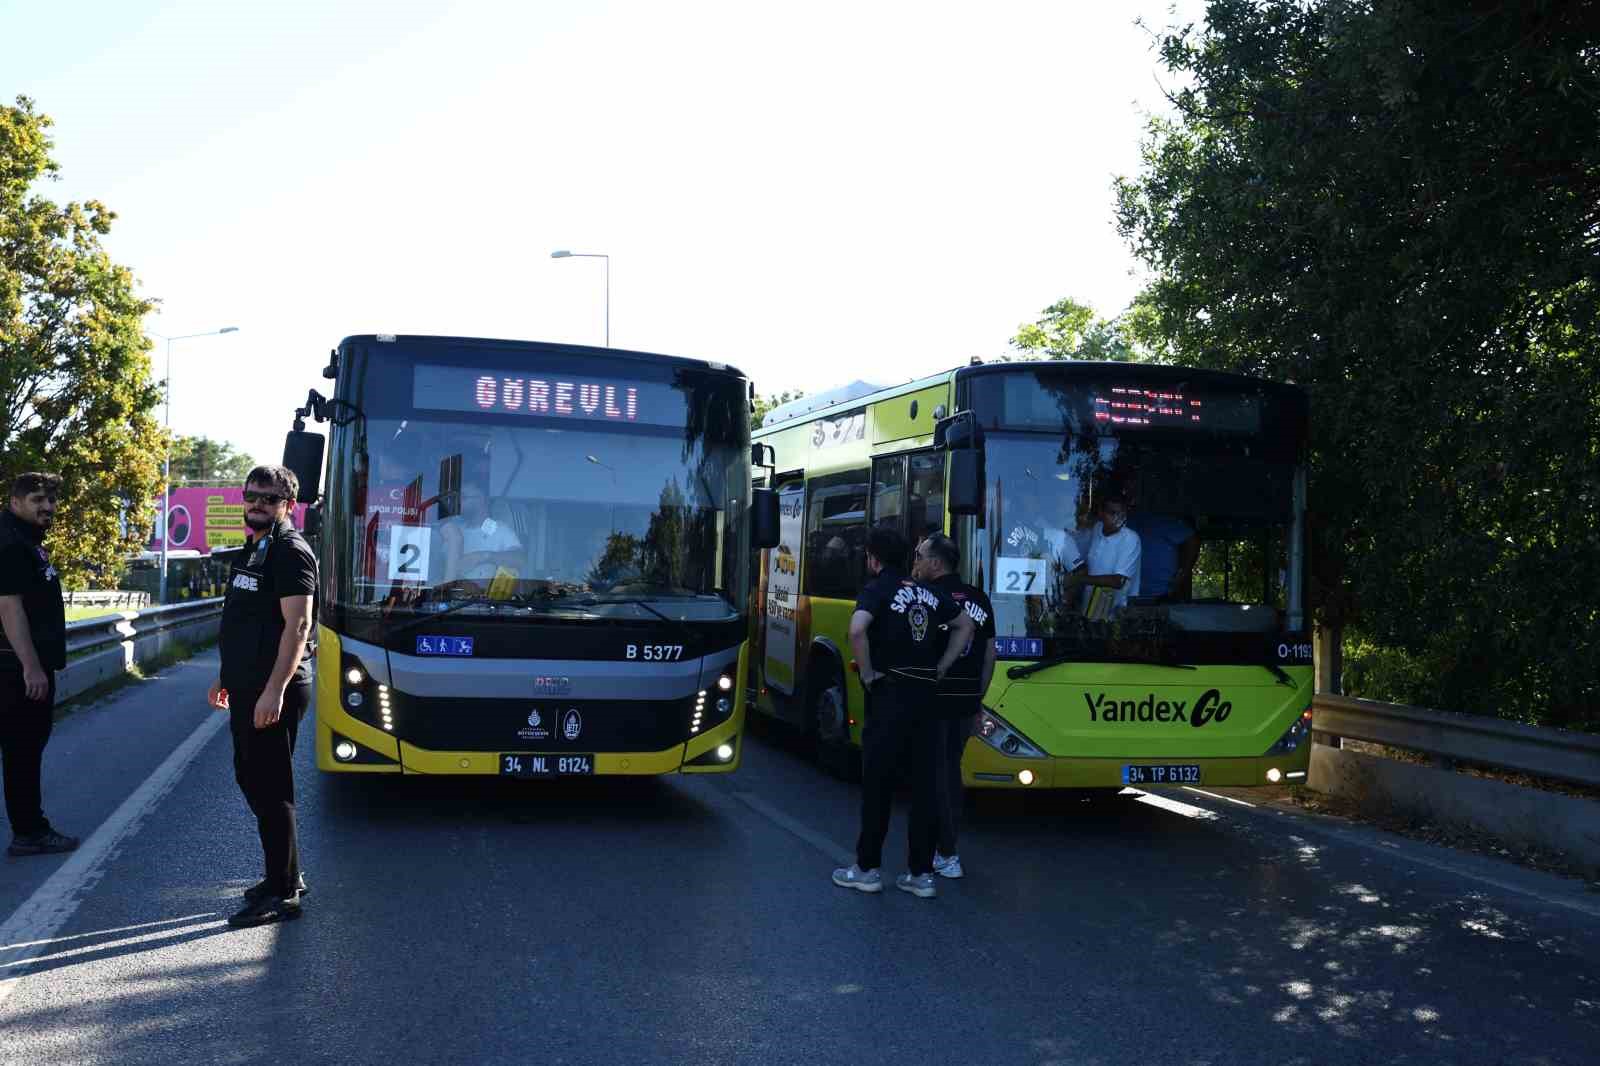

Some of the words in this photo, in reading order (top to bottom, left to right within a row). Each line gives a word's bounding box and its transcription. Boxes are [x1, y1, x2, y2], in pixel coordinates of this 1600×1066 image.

[398, 543, 421, 574] 2
[1006, 570, 1037, 592] 27
[890, 586, 916, 613] SPOR
[626, 644, 638, 659] B
[643, 644, 683, 660] 5377
[1084, 692, 1188, 722] Yandex
[1190, 688, 1232, 728] Go
[504, 756, 521, 773] 34
[532, 756, 549, 773] NL
[1129, 767, 1145, 782] 34
[1151, 767, 1165, 781] TP
[1169, 767, 1198, 781] 6132
